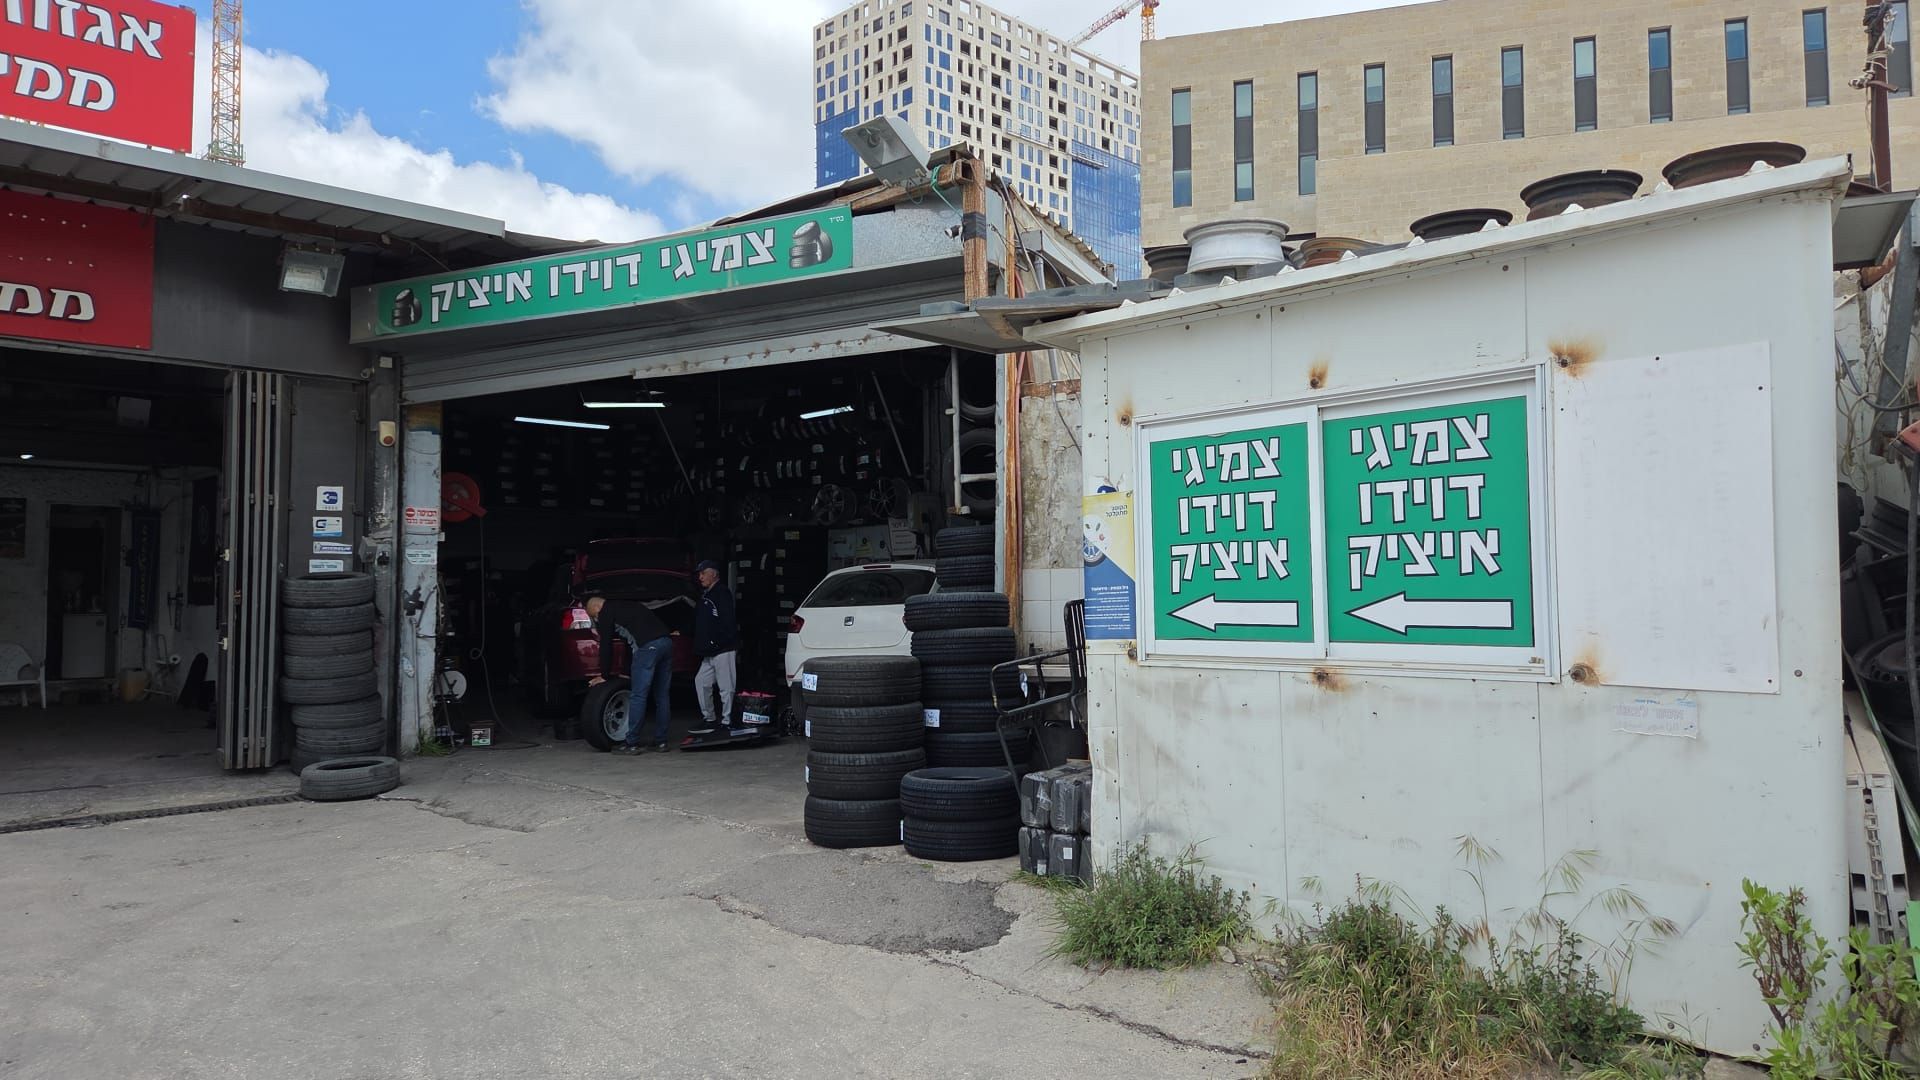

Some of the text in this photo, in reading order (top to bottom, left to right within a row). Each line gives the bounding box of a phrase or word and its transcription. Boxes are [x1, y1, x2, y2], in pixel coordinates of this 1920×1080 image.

[430, 226, 775, 325] צמיגי דוידו איציק
[1171, 437, 1282, 487] צמיגי
[1350, 413, 1492, 471] צמיגי
[1178, 489, 1278, 536] דוידו
[1358, 473, 1486, 525] דוידו
[1170, 538, 1291, 595] איציק
[1347, 528, 1501, 592] איציק
